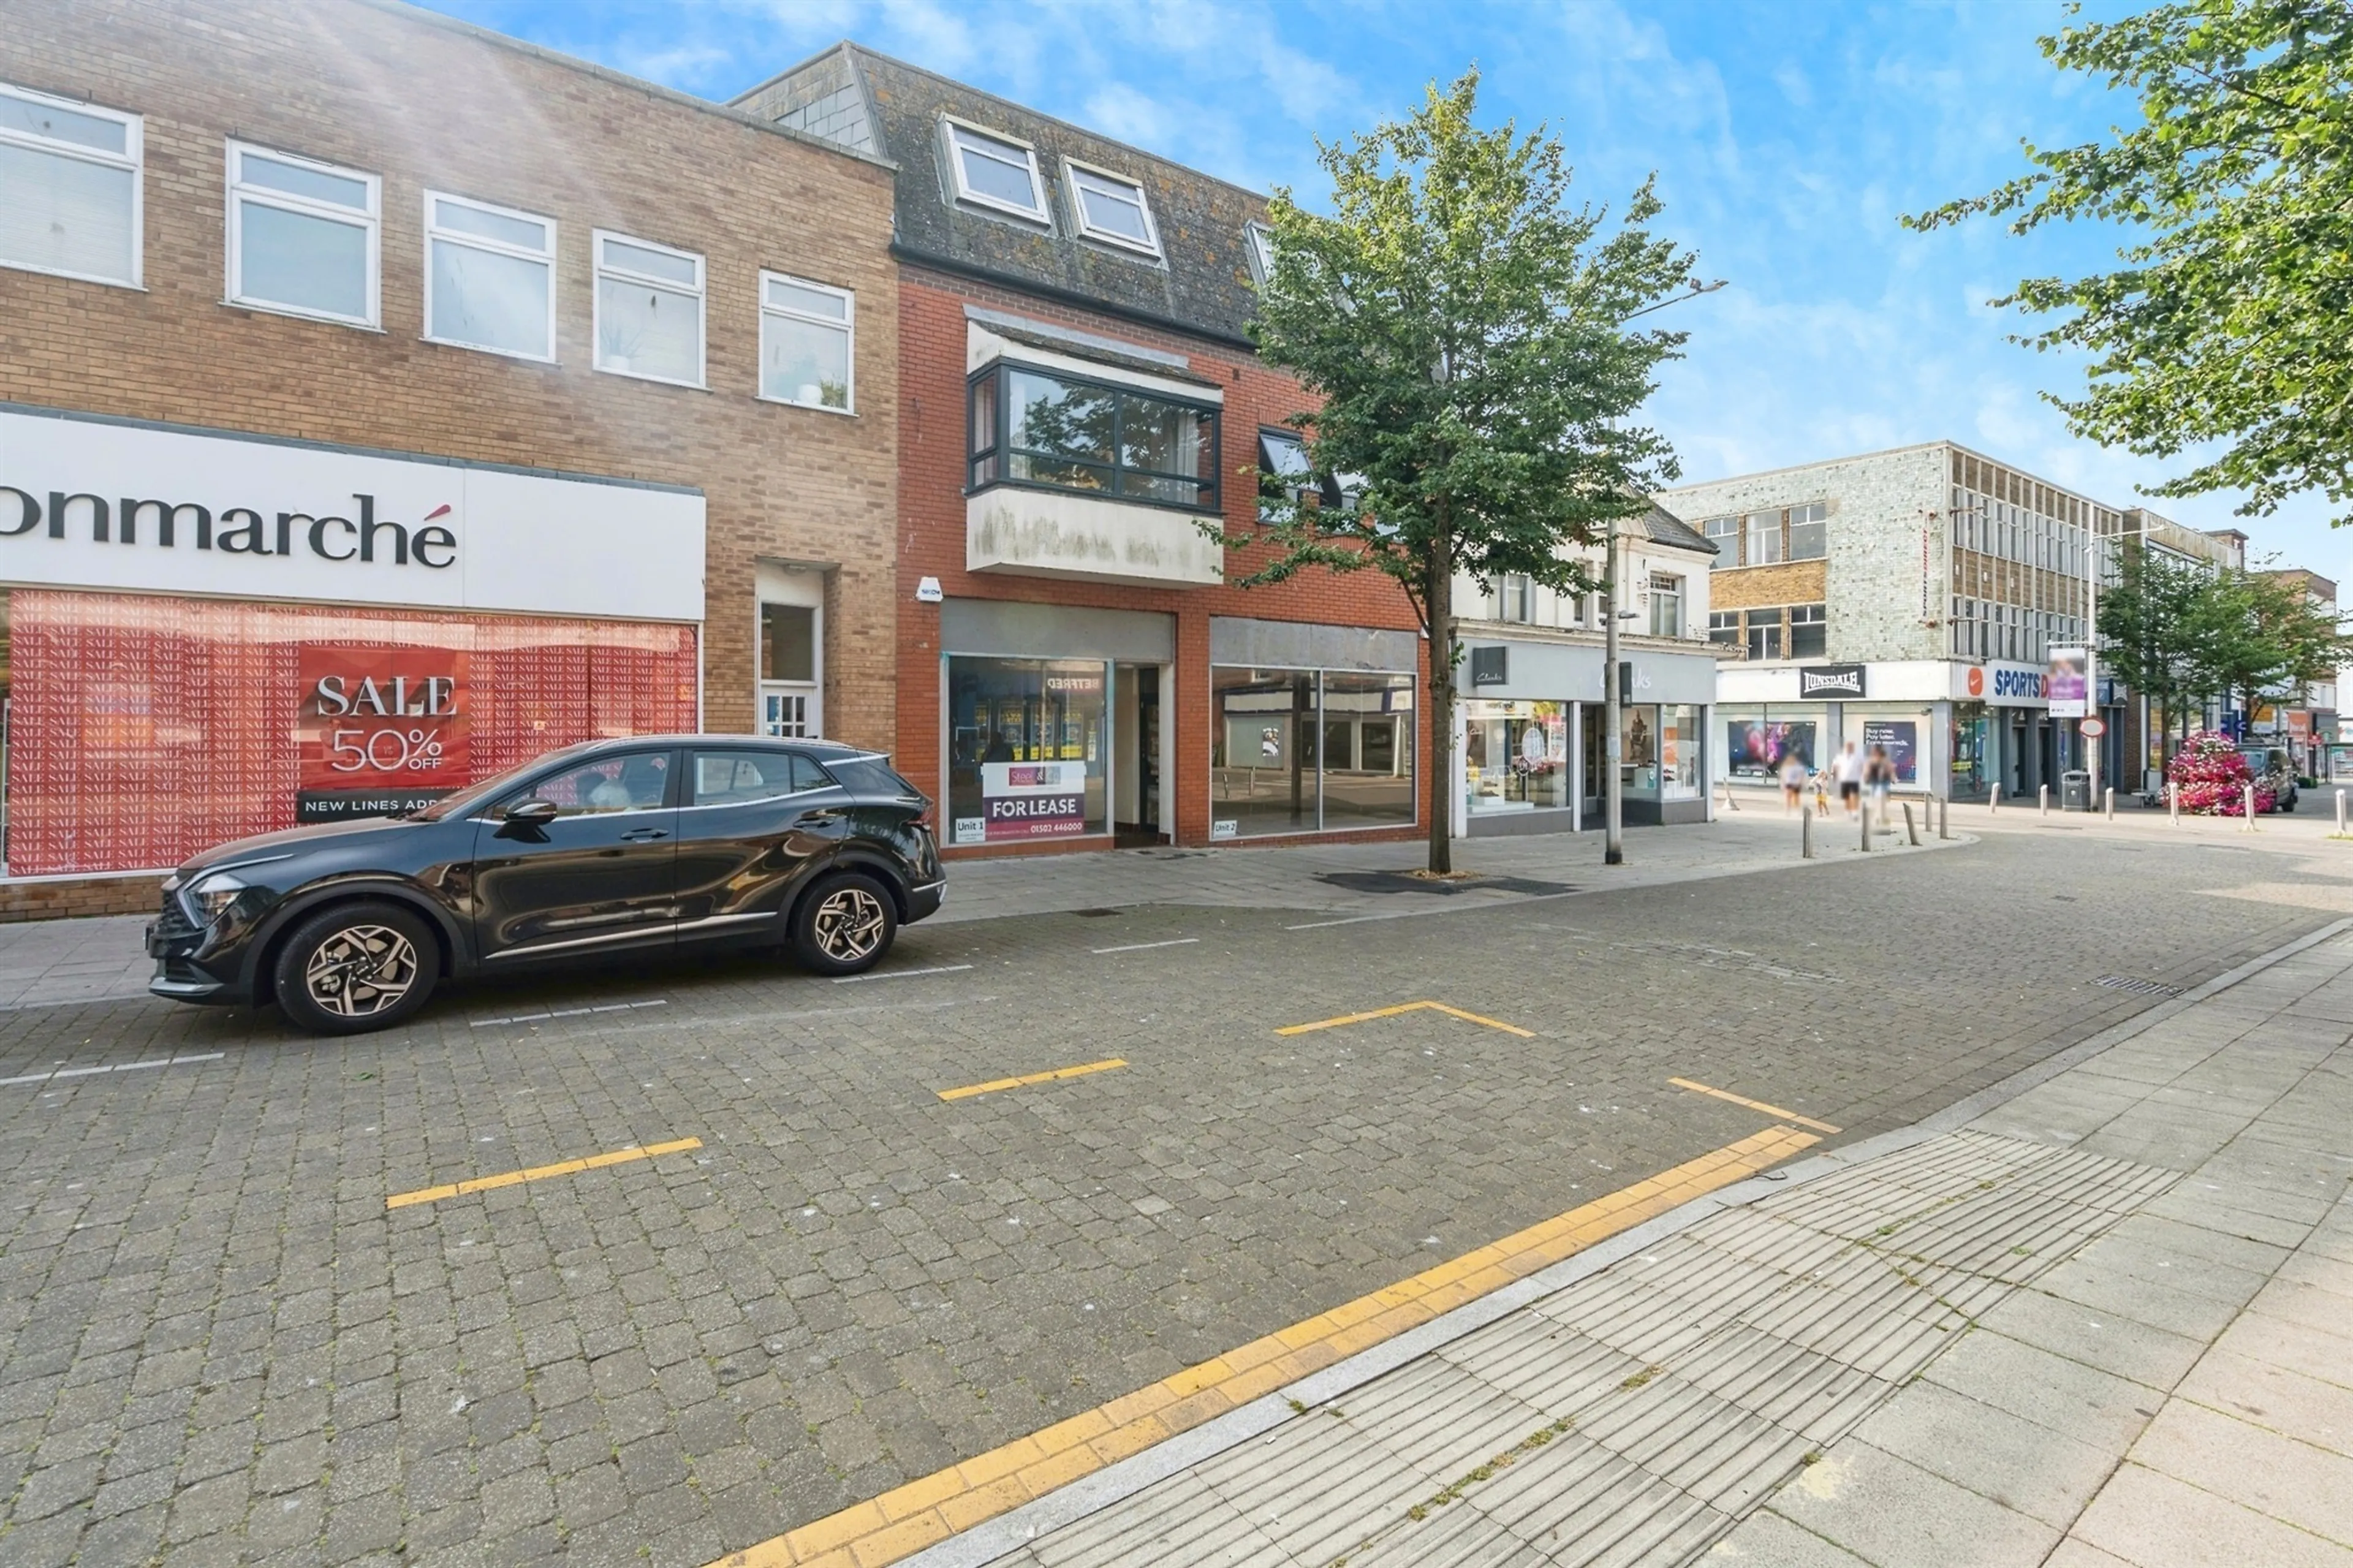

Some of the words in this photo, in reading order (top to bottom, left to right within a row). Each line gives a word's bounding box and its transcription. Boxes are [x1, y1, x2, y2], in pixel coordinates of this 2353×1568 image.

[317, 675, 457, 717] SALE
[332, 729, 442, 771] 50%
[409, 758, 442, 770] OFF
[1037, 771, 1044, 781] &
[305, 801, 345, 811] NEW
[352, 800, 398, 811] LINES
[993, 800, 1027, 817] FOR
[1029, 798, 1077, 816] LEASE
[958, 822, 976, 831] Unit
[979, 821, 983, 830] 1
[1030, 824, 1052, 834] 01502
[1053, 822, 1083, 832] 446000
